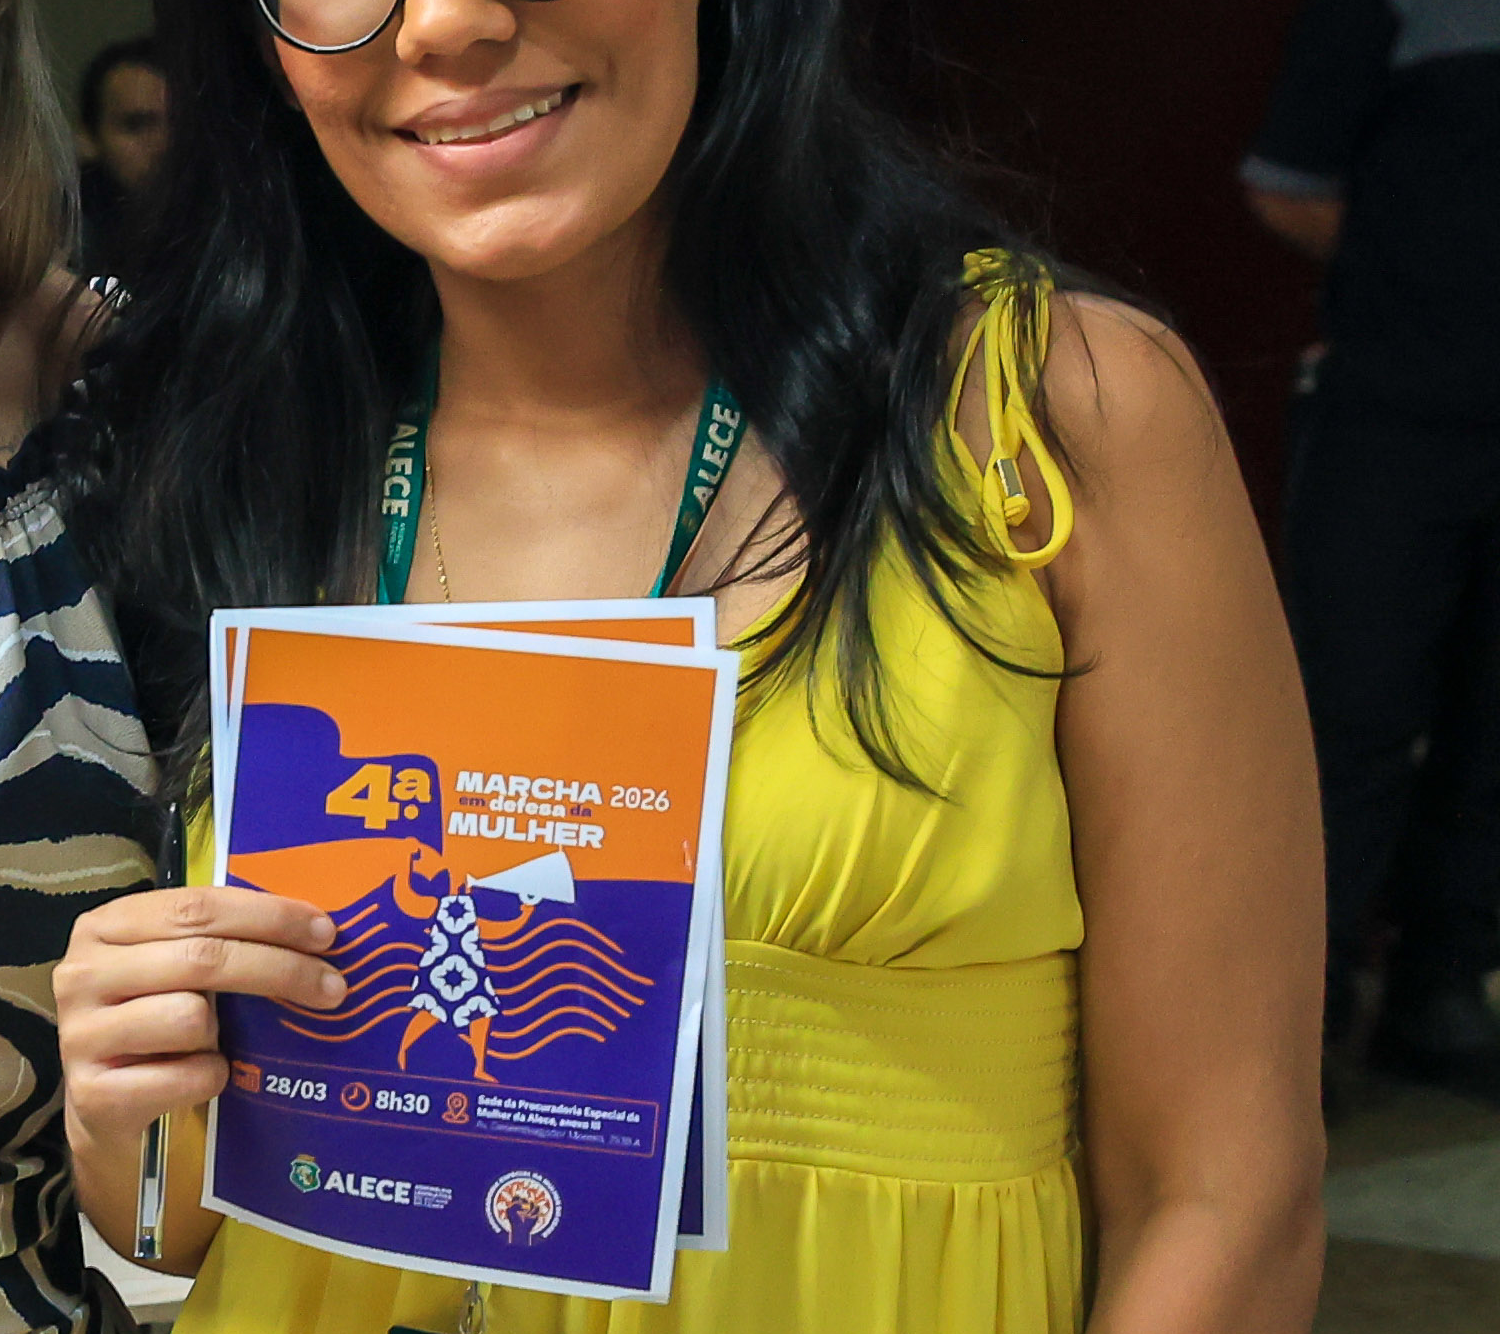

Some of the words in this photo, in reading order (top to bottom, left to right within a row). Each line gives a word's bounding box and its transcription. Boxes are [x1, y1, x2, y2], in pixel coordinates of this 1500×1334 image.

[381, 423, 419, 518] ALECE
[691, 402, 742, 513] ALECE
[455, 770, 603, 805] MARCHA
[609, 785, 671, 812] 2026
[488, 795, 566, 818] defesa
[447, 811, 606, 849] MULHER
[265, 1074, 328, 1102] 28/03
[374, 1089, 431, 1115] 8h30
[323, 1169, 412, 1205] ALECE
